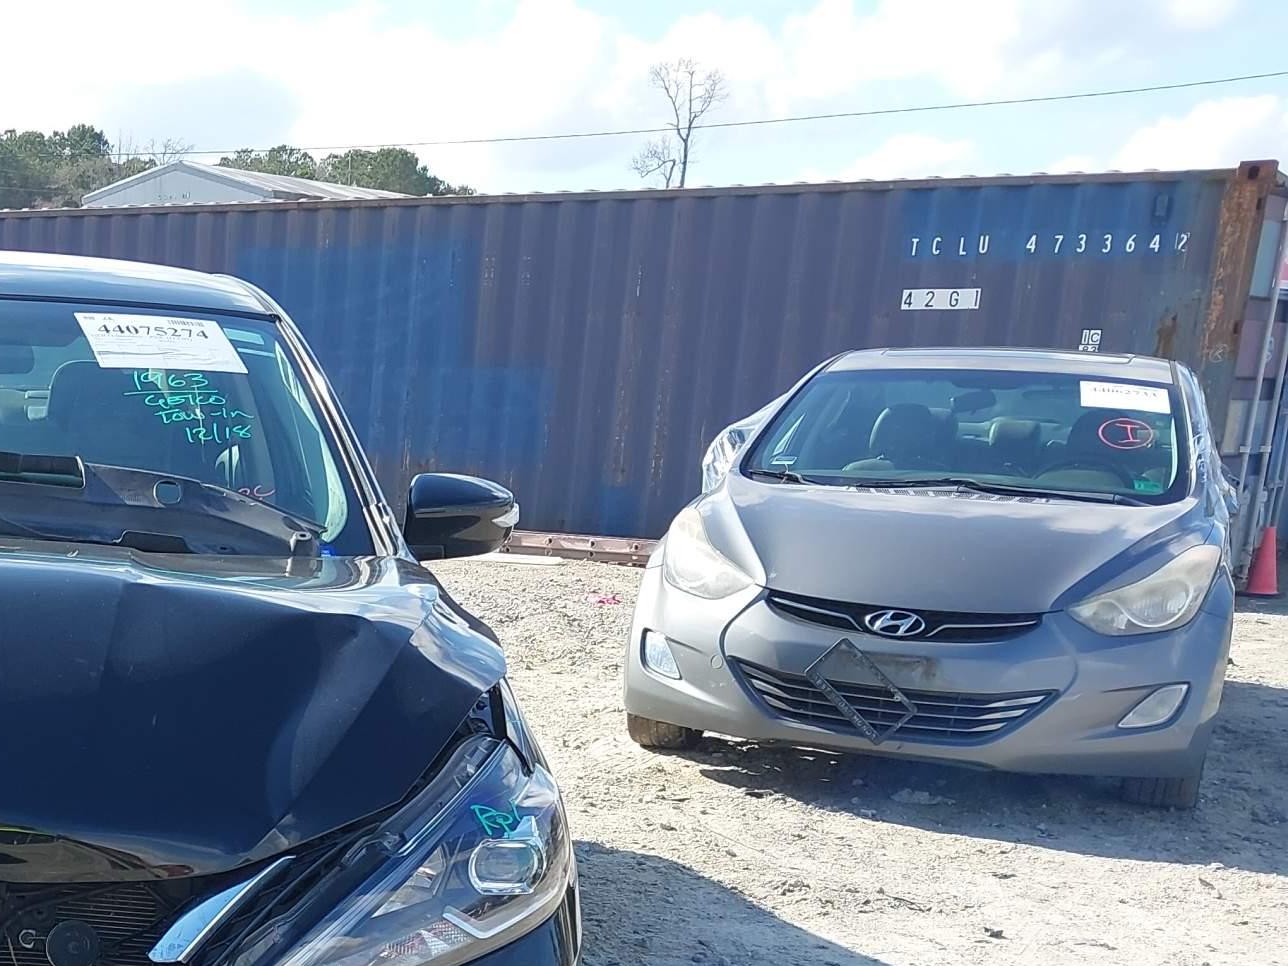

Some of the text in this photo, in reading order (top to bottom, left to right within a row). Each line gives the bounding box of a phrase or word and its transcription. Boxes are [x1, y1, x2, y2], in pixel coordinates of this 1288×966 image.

[97, 323, 210, 340] 44075274
[133, 370, 209, 391] 1963
[185, 422, 252, 444] 12/18
